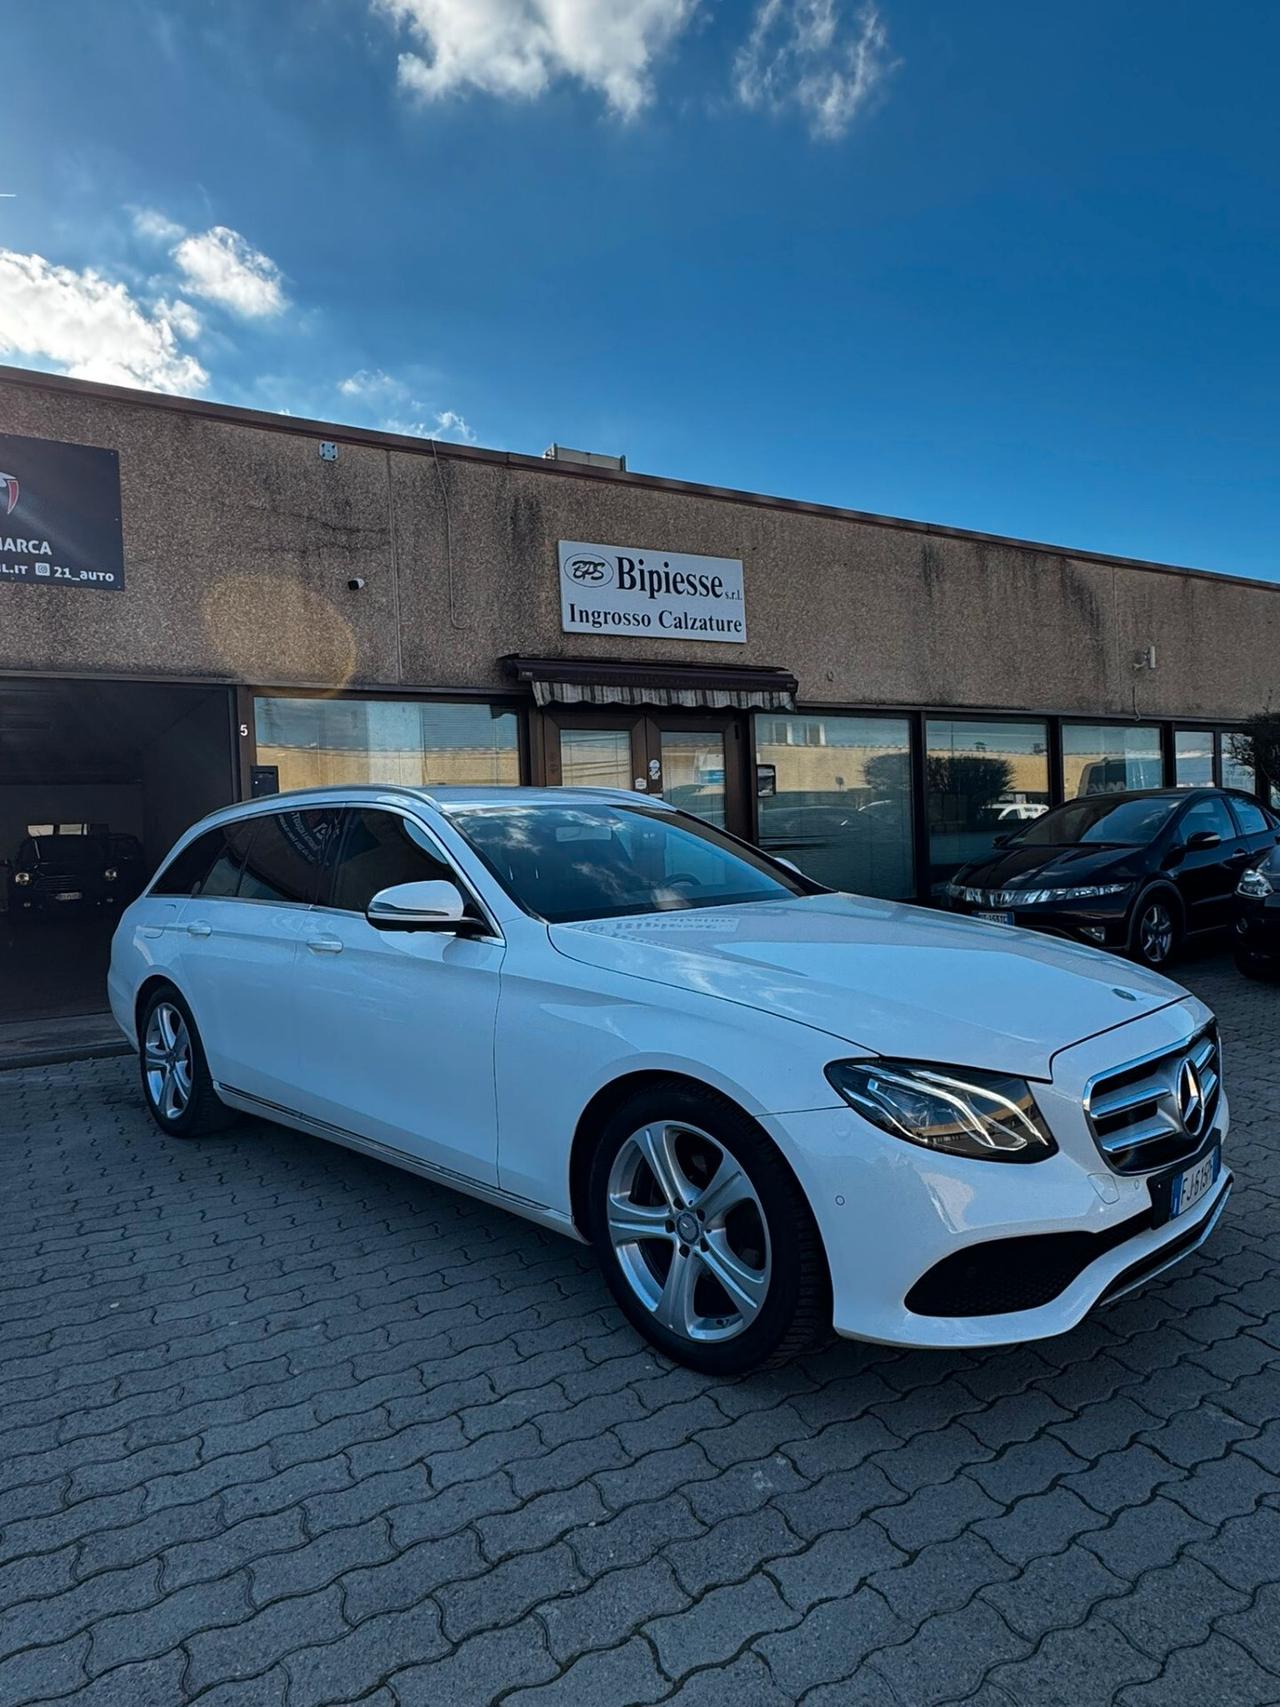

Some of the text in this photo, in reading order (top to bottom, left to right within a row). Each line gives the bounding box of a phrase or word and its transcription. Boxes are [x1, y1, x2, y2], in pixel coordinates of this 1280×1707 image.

[0, 537, 53, 556] ARCA
[571, 560, 606, 581] BPS
[615, 556, 743, 601] Bipiesse s.r.l.
[568, 603, 743, 633] Ingrosso Calzature
[240, 724, 248, 737] 5
